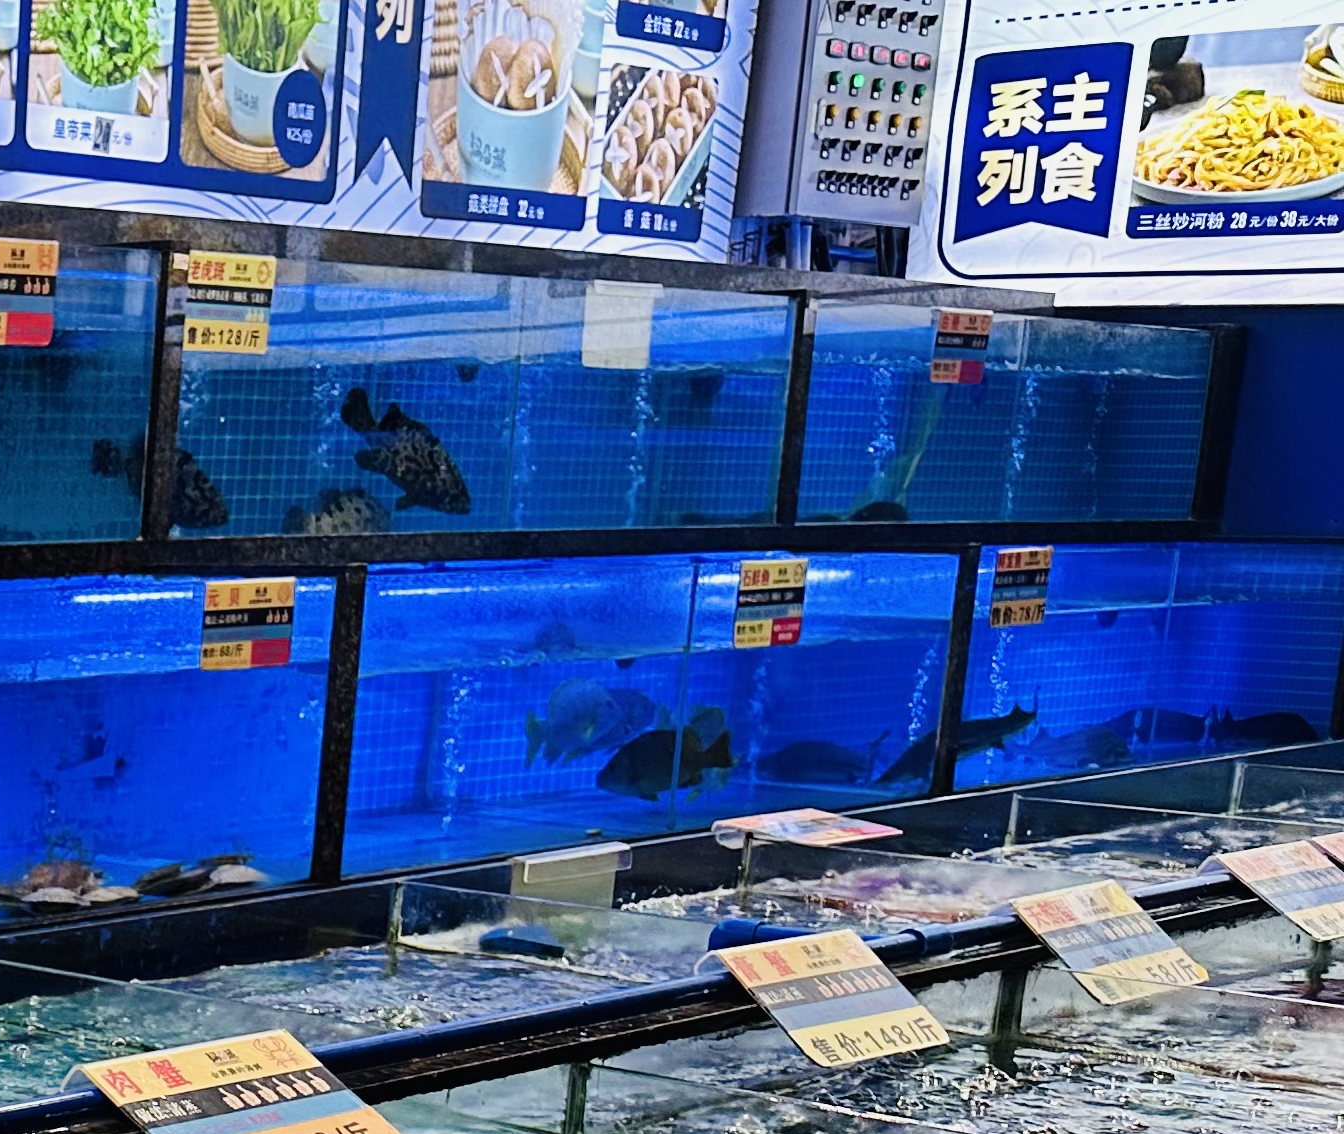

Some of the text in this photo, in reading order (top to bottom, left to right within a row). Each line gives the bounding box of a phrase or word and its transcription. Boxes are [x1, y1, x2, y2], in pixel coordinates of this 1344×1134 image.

[1136, 211, 1225, 231] 三丝炒河粉
[100, 1058, 192, 1099] 肉蟹
